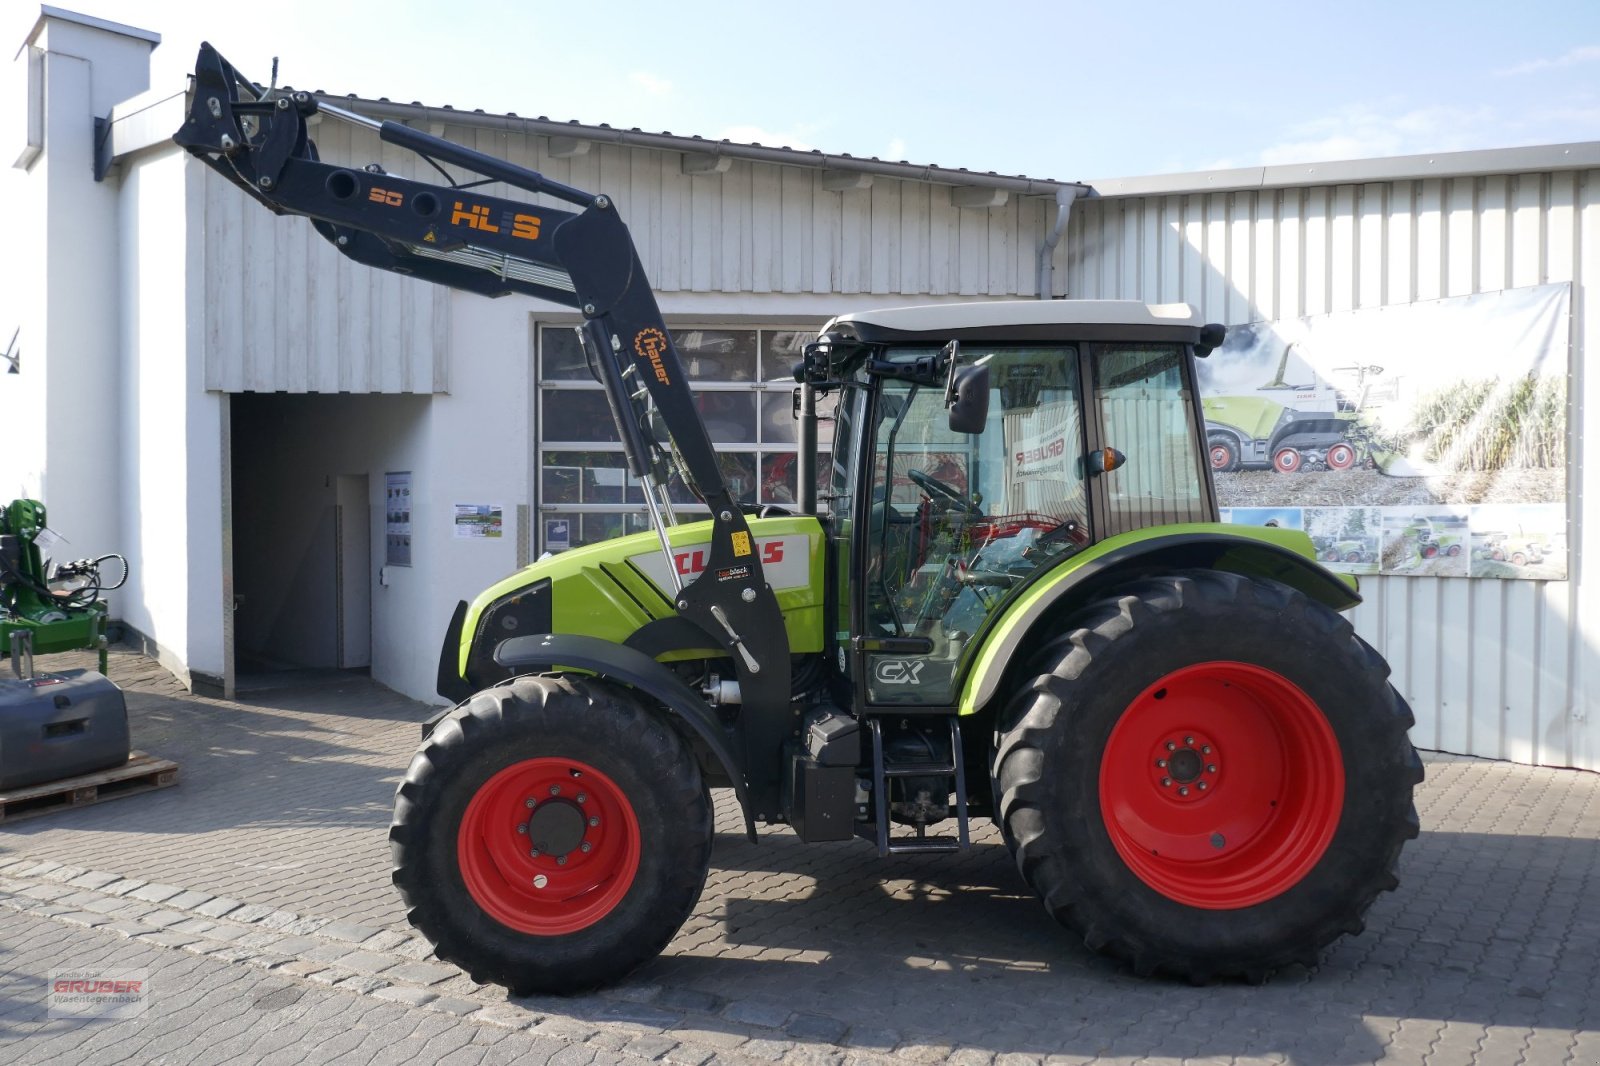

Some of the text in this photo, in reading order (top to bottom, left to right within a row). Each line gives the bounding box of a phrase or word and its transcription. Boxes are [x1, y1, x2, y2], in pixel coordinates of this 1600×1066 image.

[643, 337, 670, 385] hauer
[674, 541, 784, 575] CLS
[875, 660, 925, 684] CX
